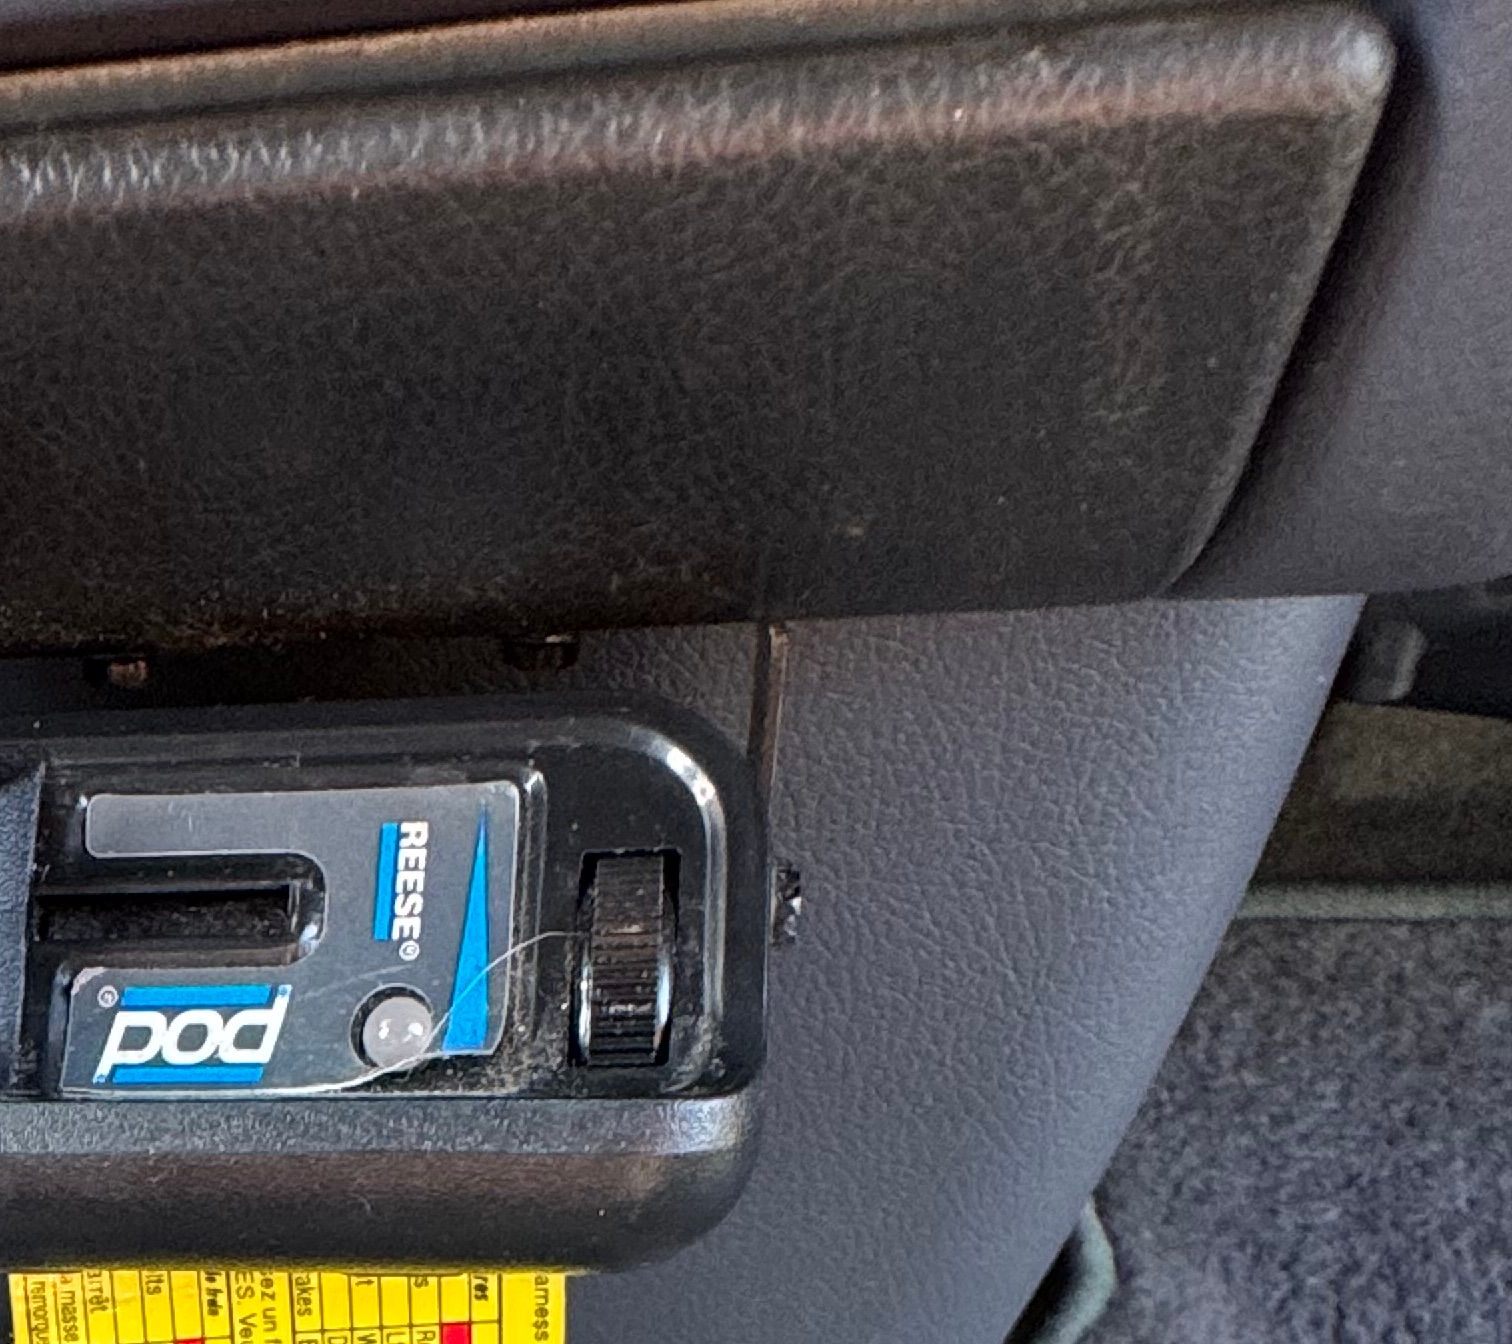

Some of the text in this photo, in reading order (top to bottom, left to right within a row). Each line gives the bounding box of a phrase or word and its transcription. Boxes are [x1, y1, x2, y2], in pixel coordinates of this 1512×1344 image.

[61, 1290, 80, 1342] masse
[295, 1273, 315, 1317] akes
[263, 1308, 278, 1332] un
